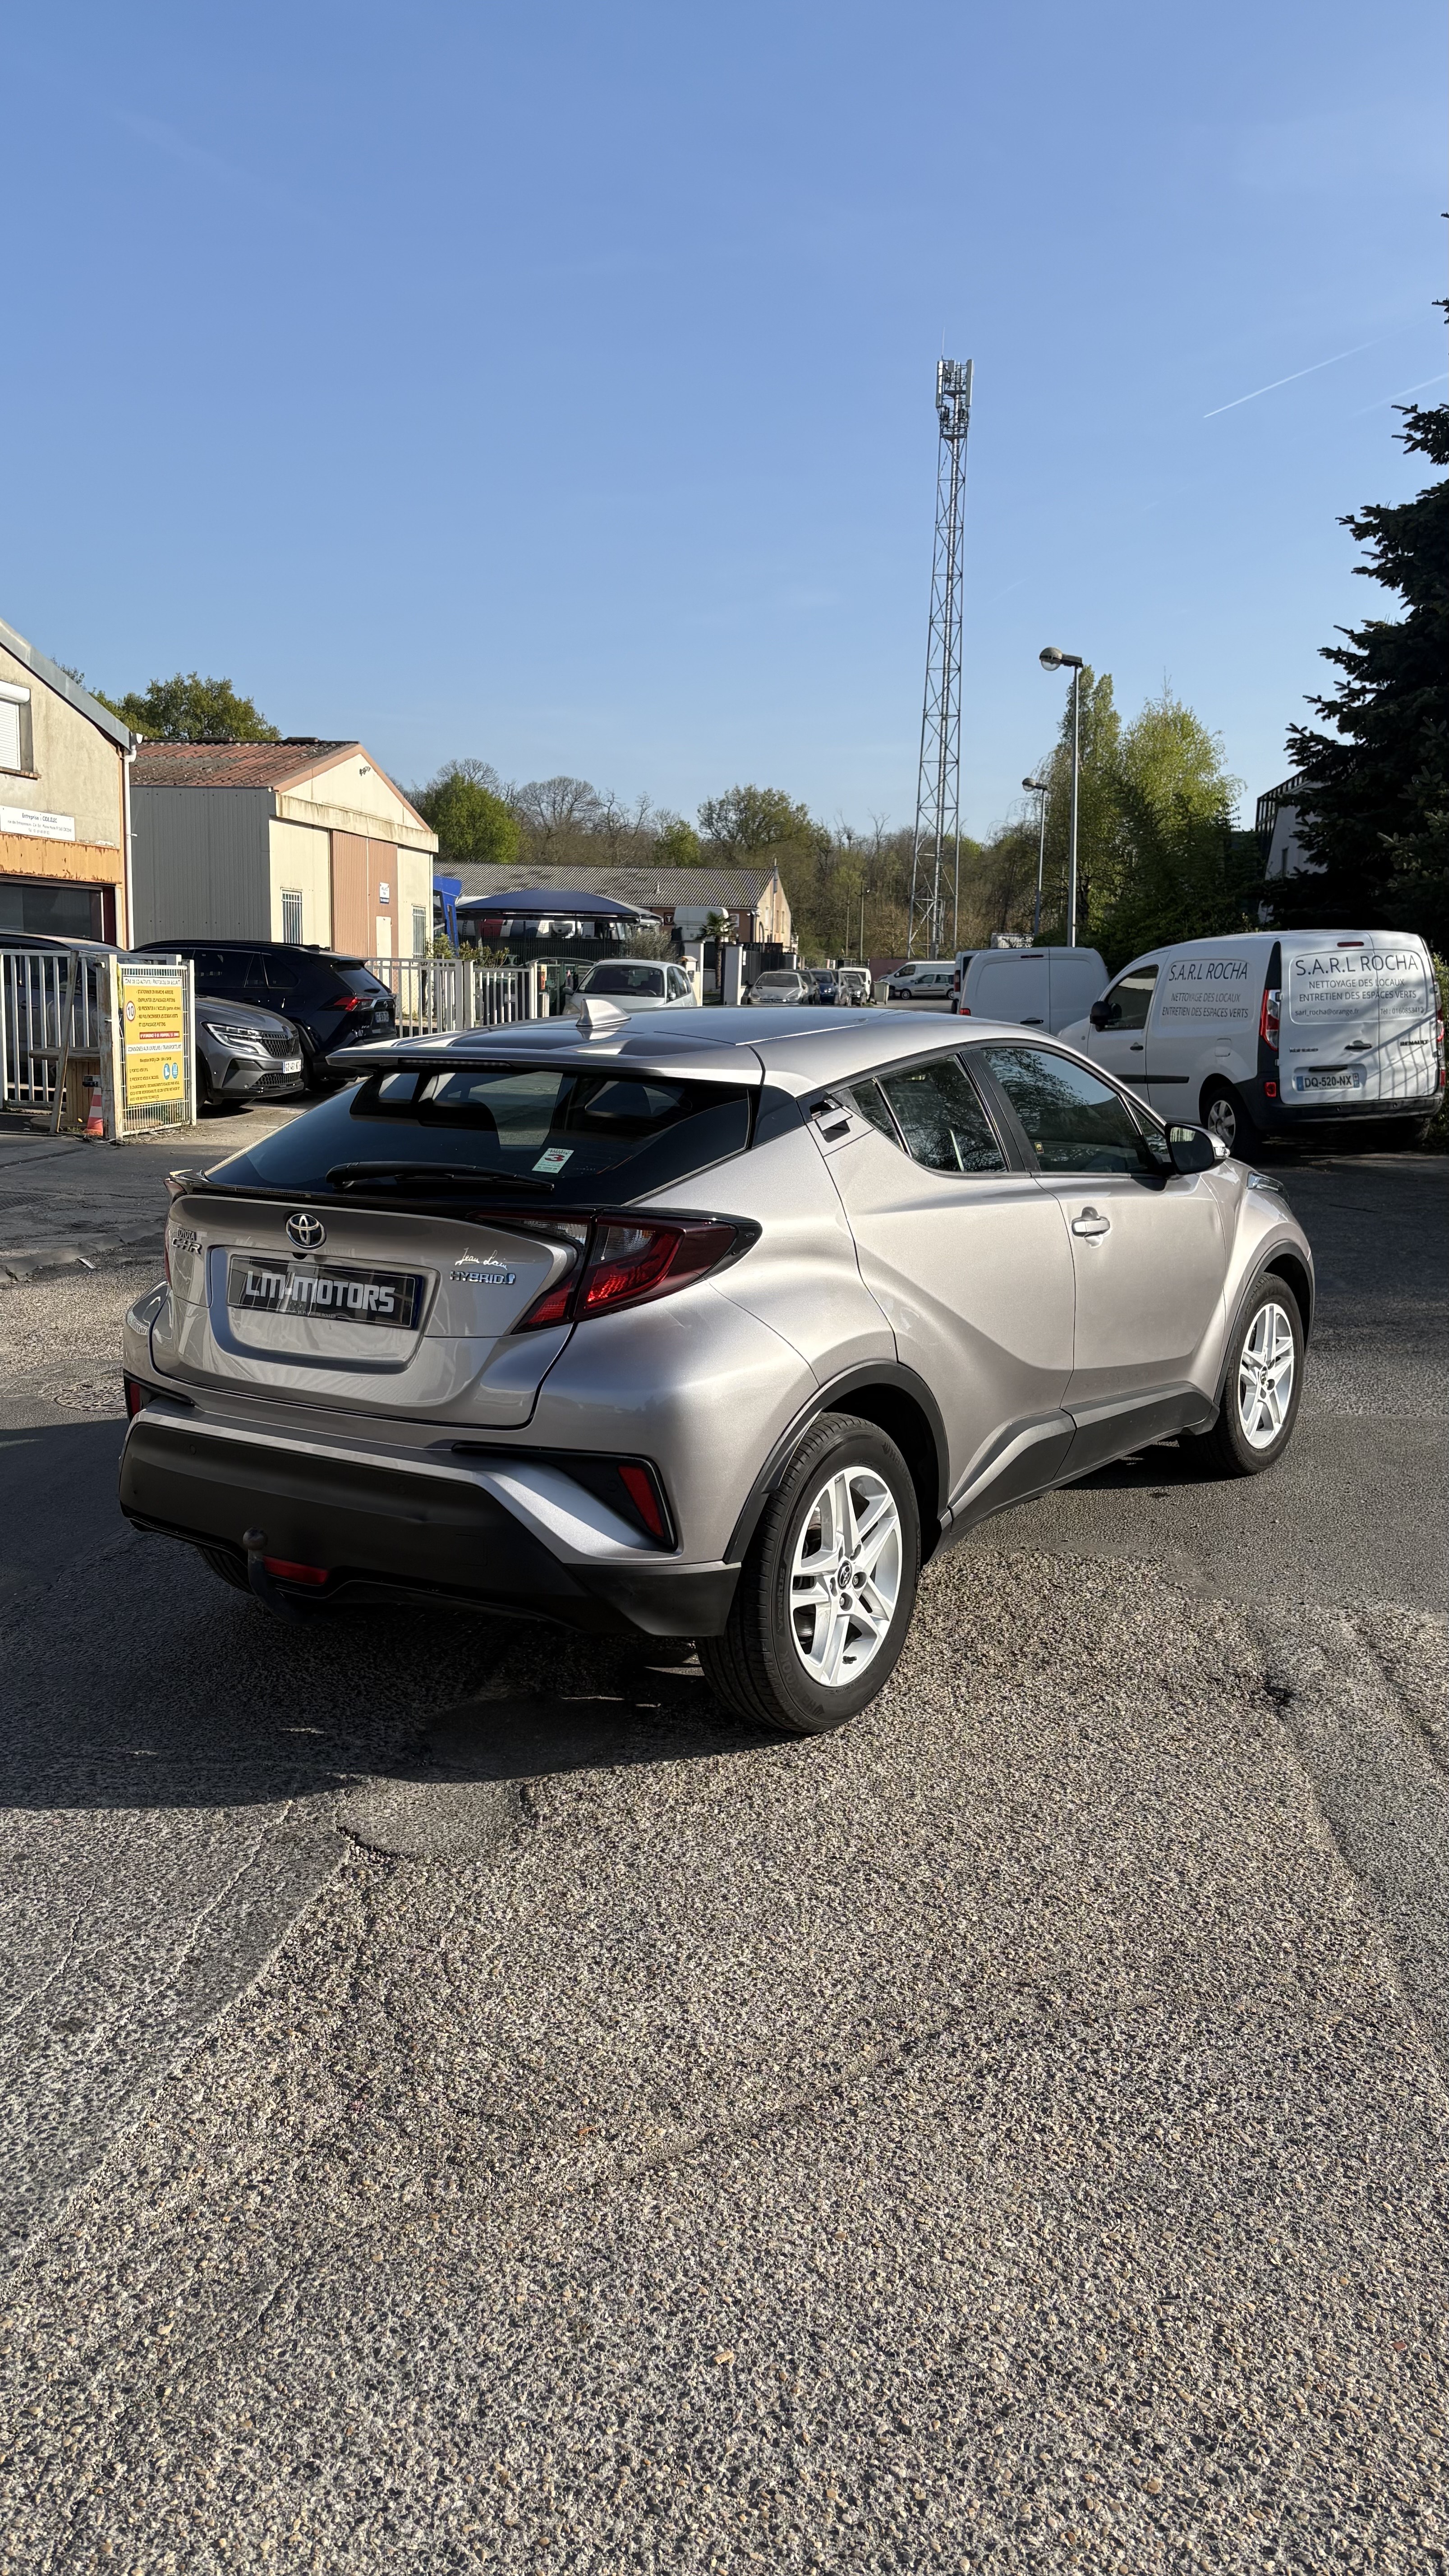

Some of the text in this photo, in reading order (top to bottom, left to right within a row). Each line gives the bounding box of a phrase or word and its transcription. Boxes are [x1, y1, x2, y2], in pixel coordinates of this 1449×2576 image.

[1295, 955, 1418, 975] S.A.R.L ROCHA
[1169, 962, 1247, 981] S.A.R.L ROCHA
[1309, 978, 1405, 989] NETTOYAGE DES LOCAUX
[1171, 993, 1241, 1003] NETTOYAGE DES LOCAUX
[1299, 990, 1417, 1002] ENTRETIEN DES ESPACES VERTS
[128, 1006, 134, 1017] 10
[1162, 1007, 1249, 1018] ENTRETIEN DES ESPACES VERTS
[1295, 1008, 1359, 1017] sarl_rocha@orange.fr
[1304, 1076, 1352, 1087] DQ-520-NX
[177, 1227, 197, 1241] TOYOTA
[455, 1247, 480, 1266] Jean
[450, 1270, 504, 1284] HYBRID
[246, 1270, 396, 1313] LM-MOTORS
